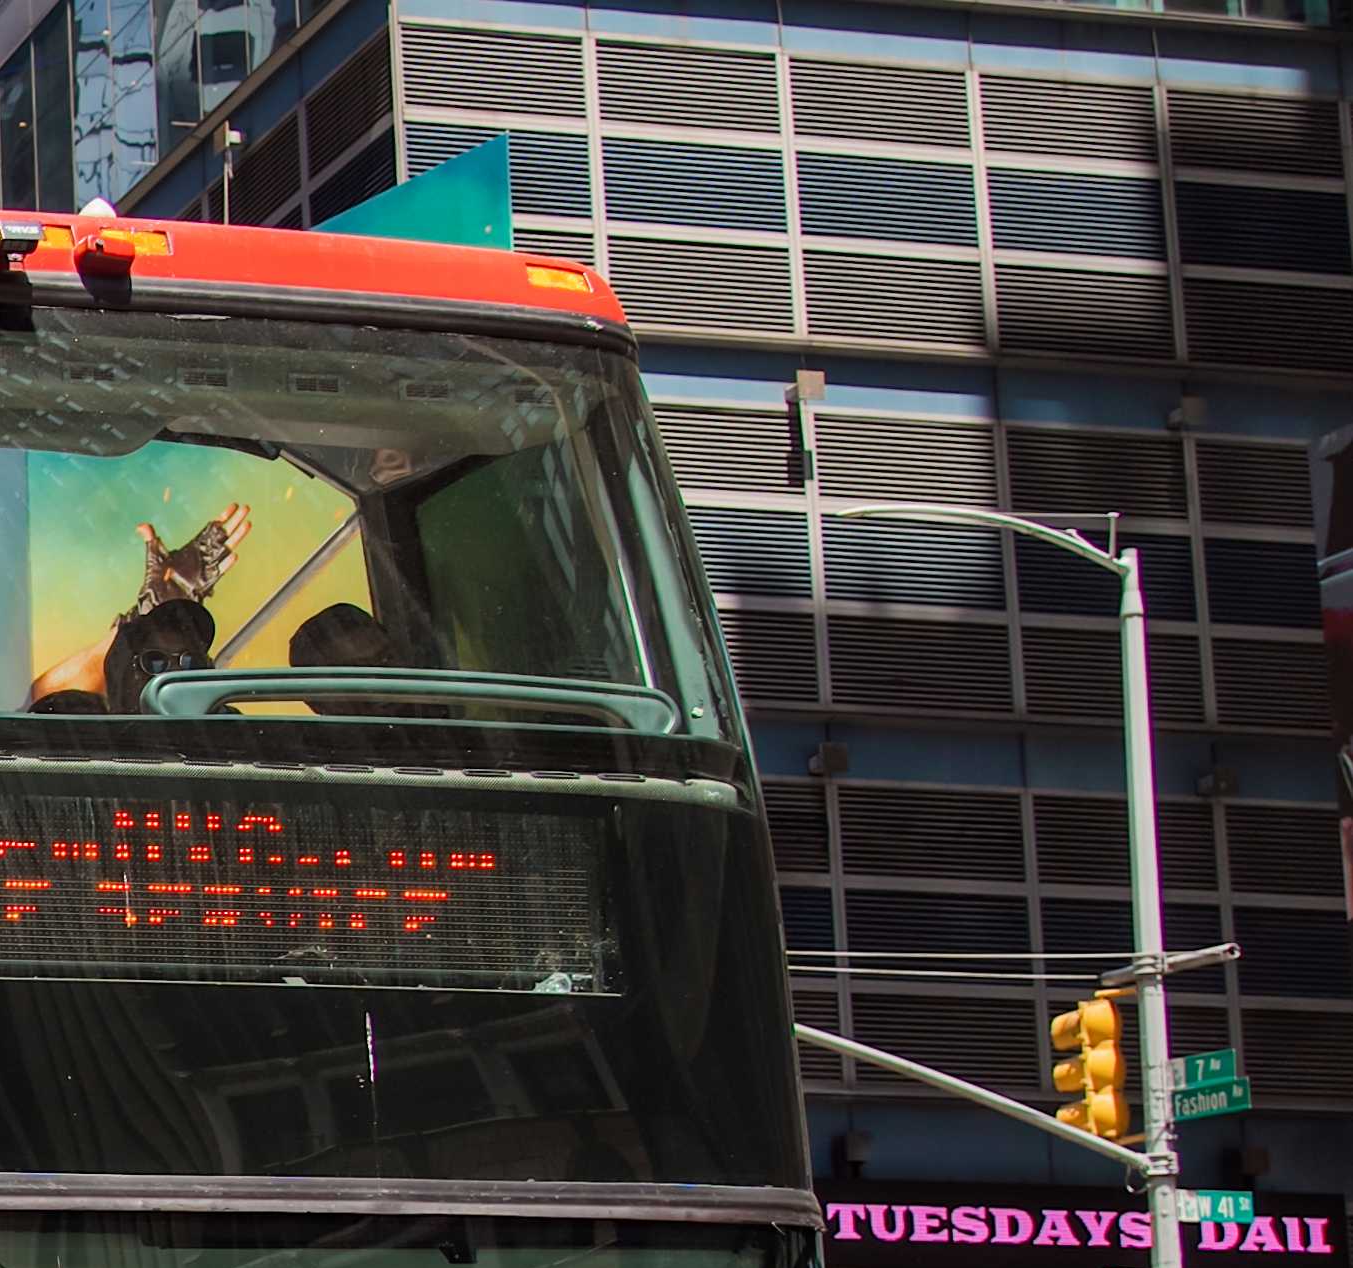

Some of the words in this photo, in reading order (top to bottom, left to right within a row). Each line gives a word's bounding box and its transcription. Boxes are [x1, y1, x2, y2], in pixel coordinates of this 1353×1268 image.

[1196, 1059, 1205, 1081] 7
[1209, 1057, 1222, 1073] Av
[1175, 1089, 1228, 1118] Fashion
[1232, 1083, 1244, 1099] Av
[1199, 1196, 1212, 1218] W
[1217, 1197, 1235, 1220] 41
[827, 1203, 1153, 1249] TUESDAYS
